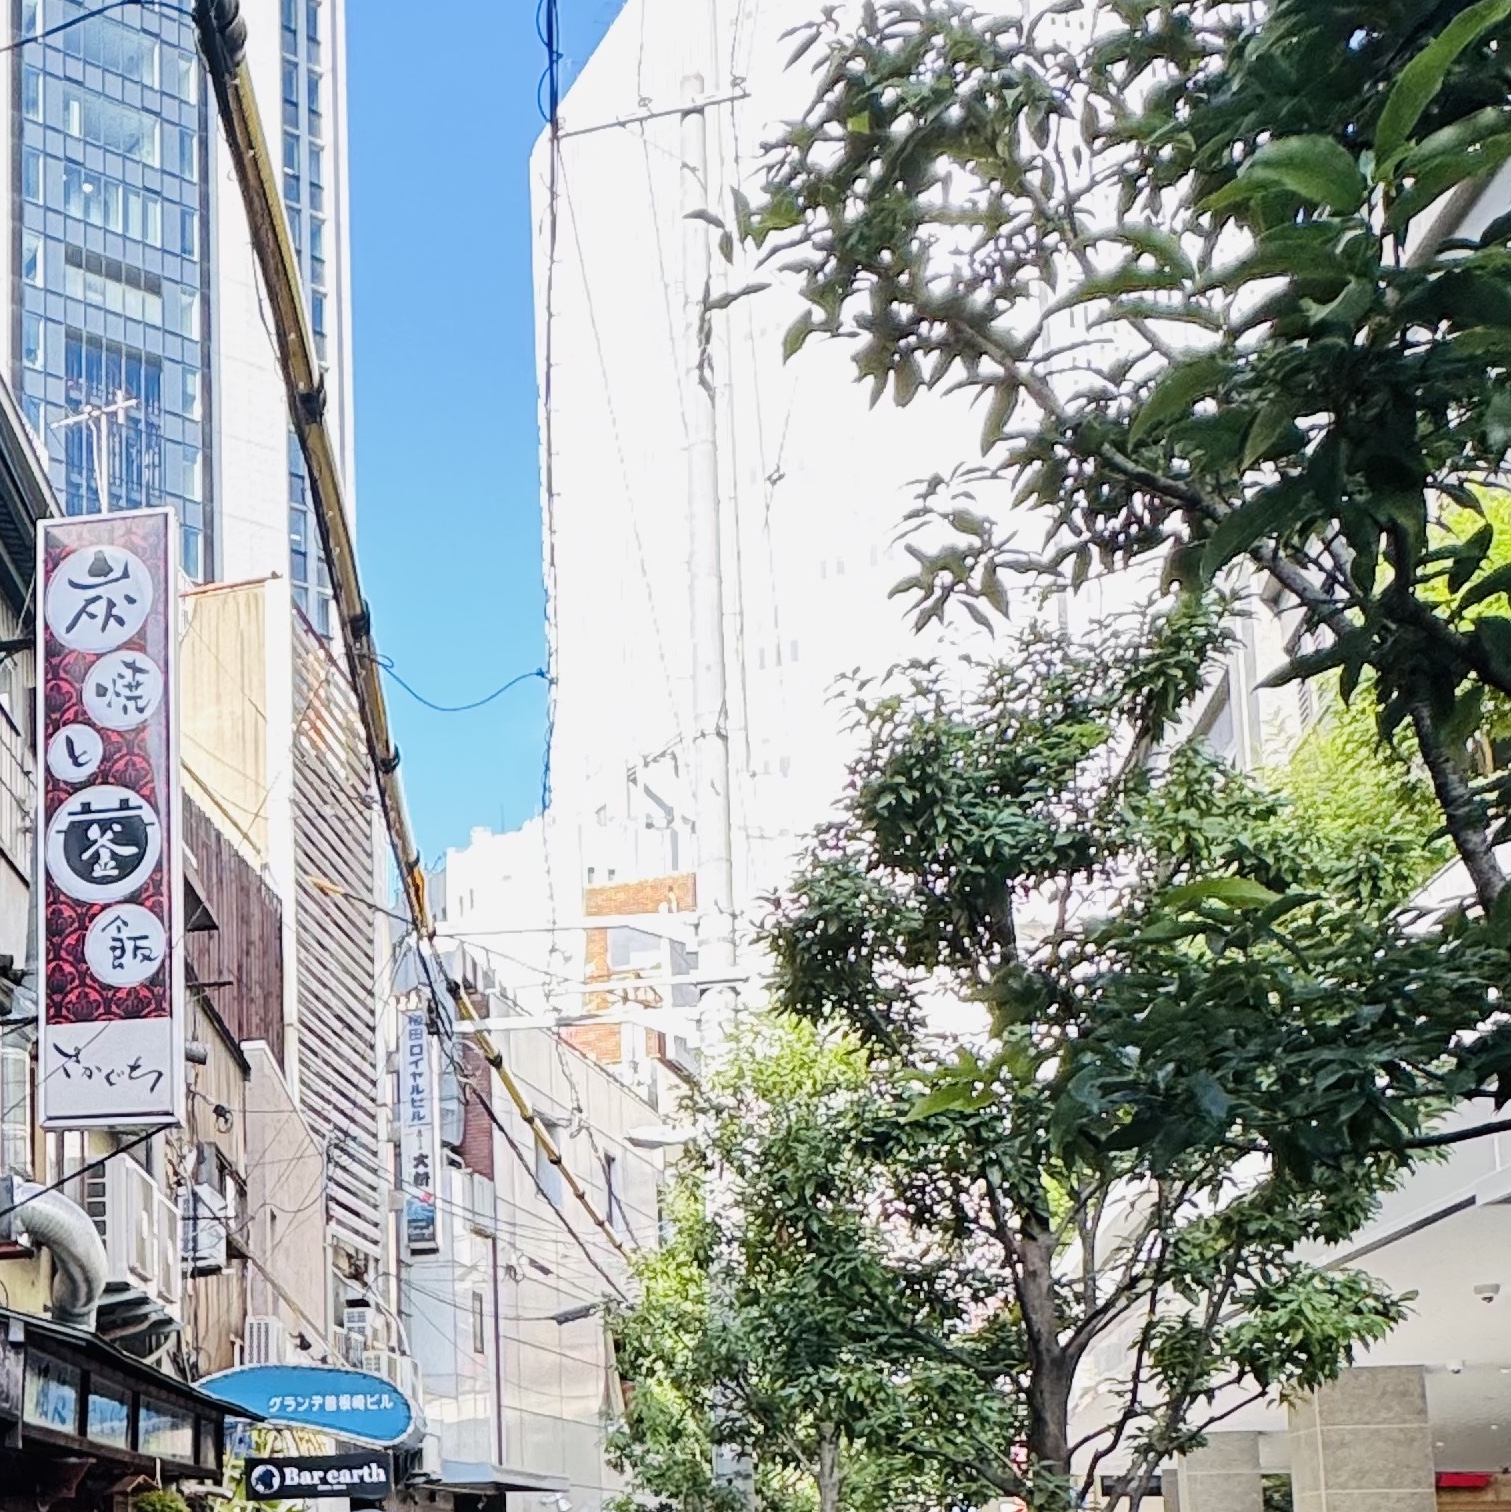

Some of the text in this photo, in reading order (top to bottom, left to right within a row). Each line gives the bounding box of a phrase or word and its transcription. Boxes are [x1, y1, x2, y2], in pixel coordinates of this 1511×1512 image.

[56, 549, 161, 971] 炭焼と釜飯
[52, 1042, 164, 1094] さかぐち
[283, 1462, 387, 1487] Bar earth
